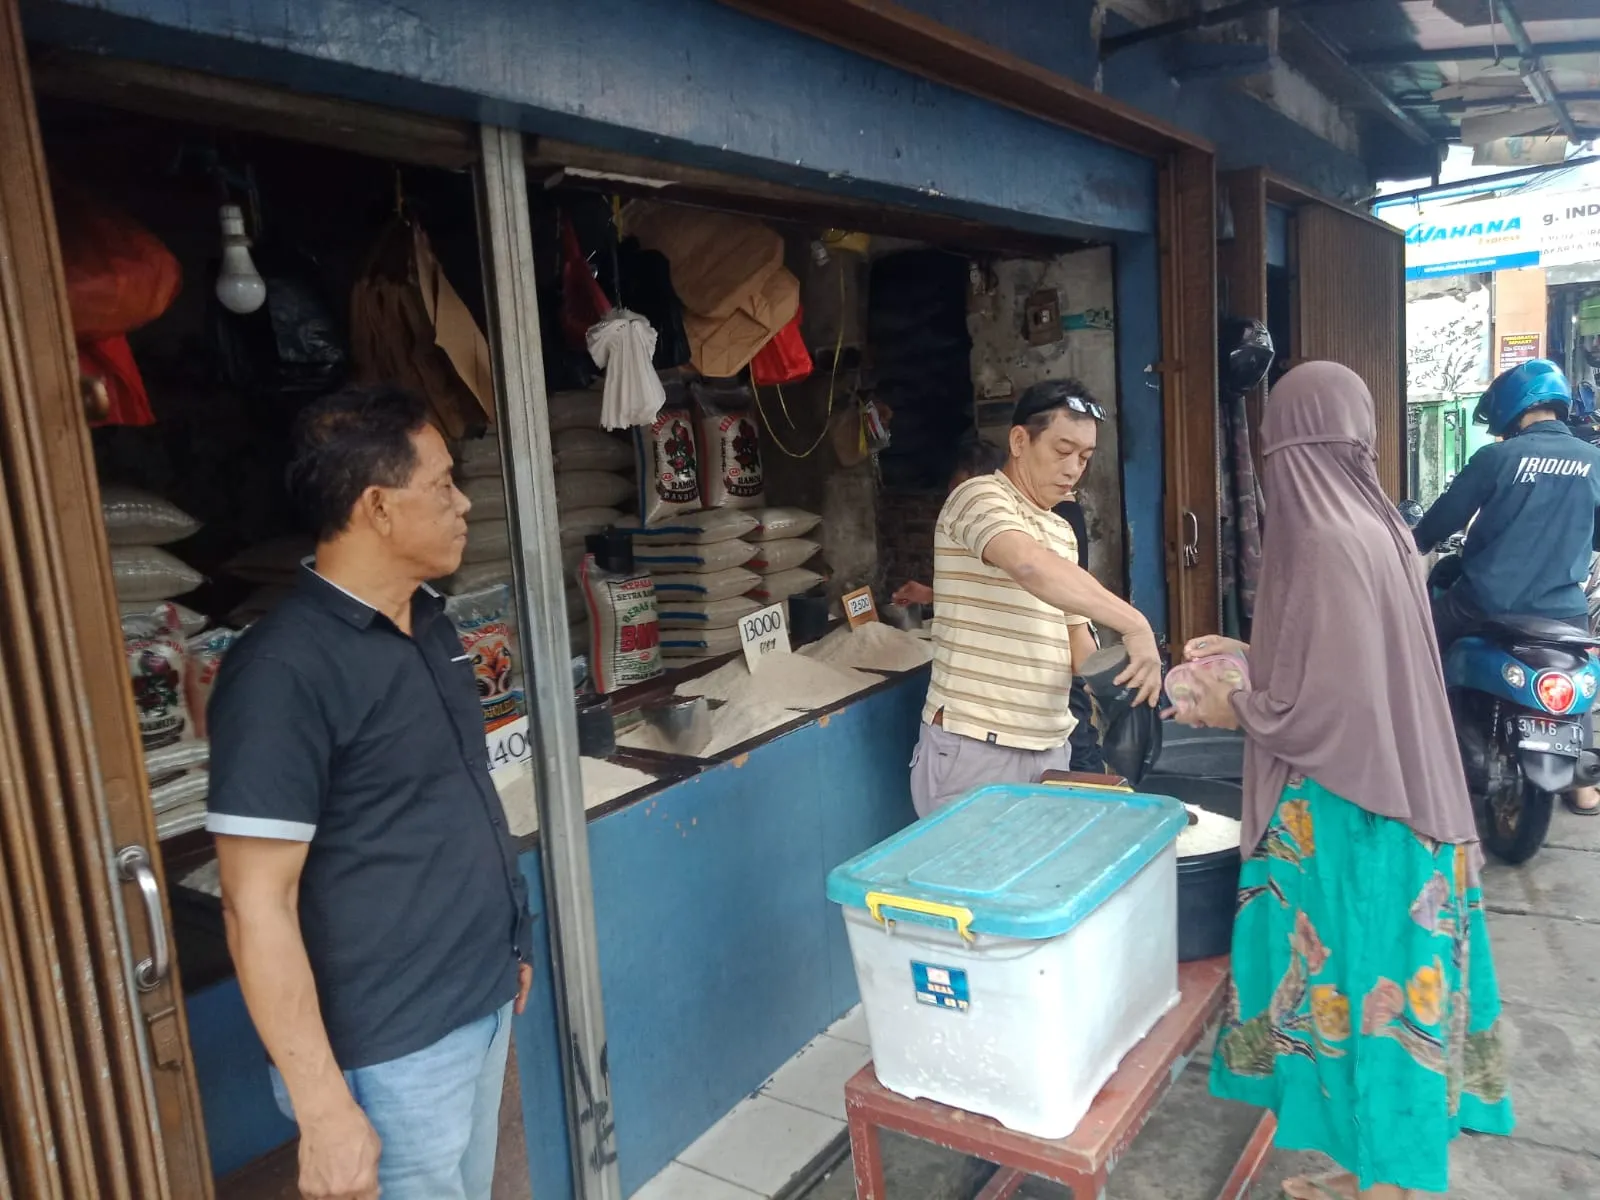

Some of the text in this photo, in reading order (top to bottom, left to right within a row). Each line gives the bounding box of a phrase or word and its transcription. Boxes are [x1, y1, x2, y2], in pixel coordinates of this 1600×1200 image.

[1405, 216, 1521, 245] WAHANA
[1512, 457, 1592, 485] IRIDIUM
[743, 610, 781, 643] 13000
[1518, 718, 1557, 736] 3116
